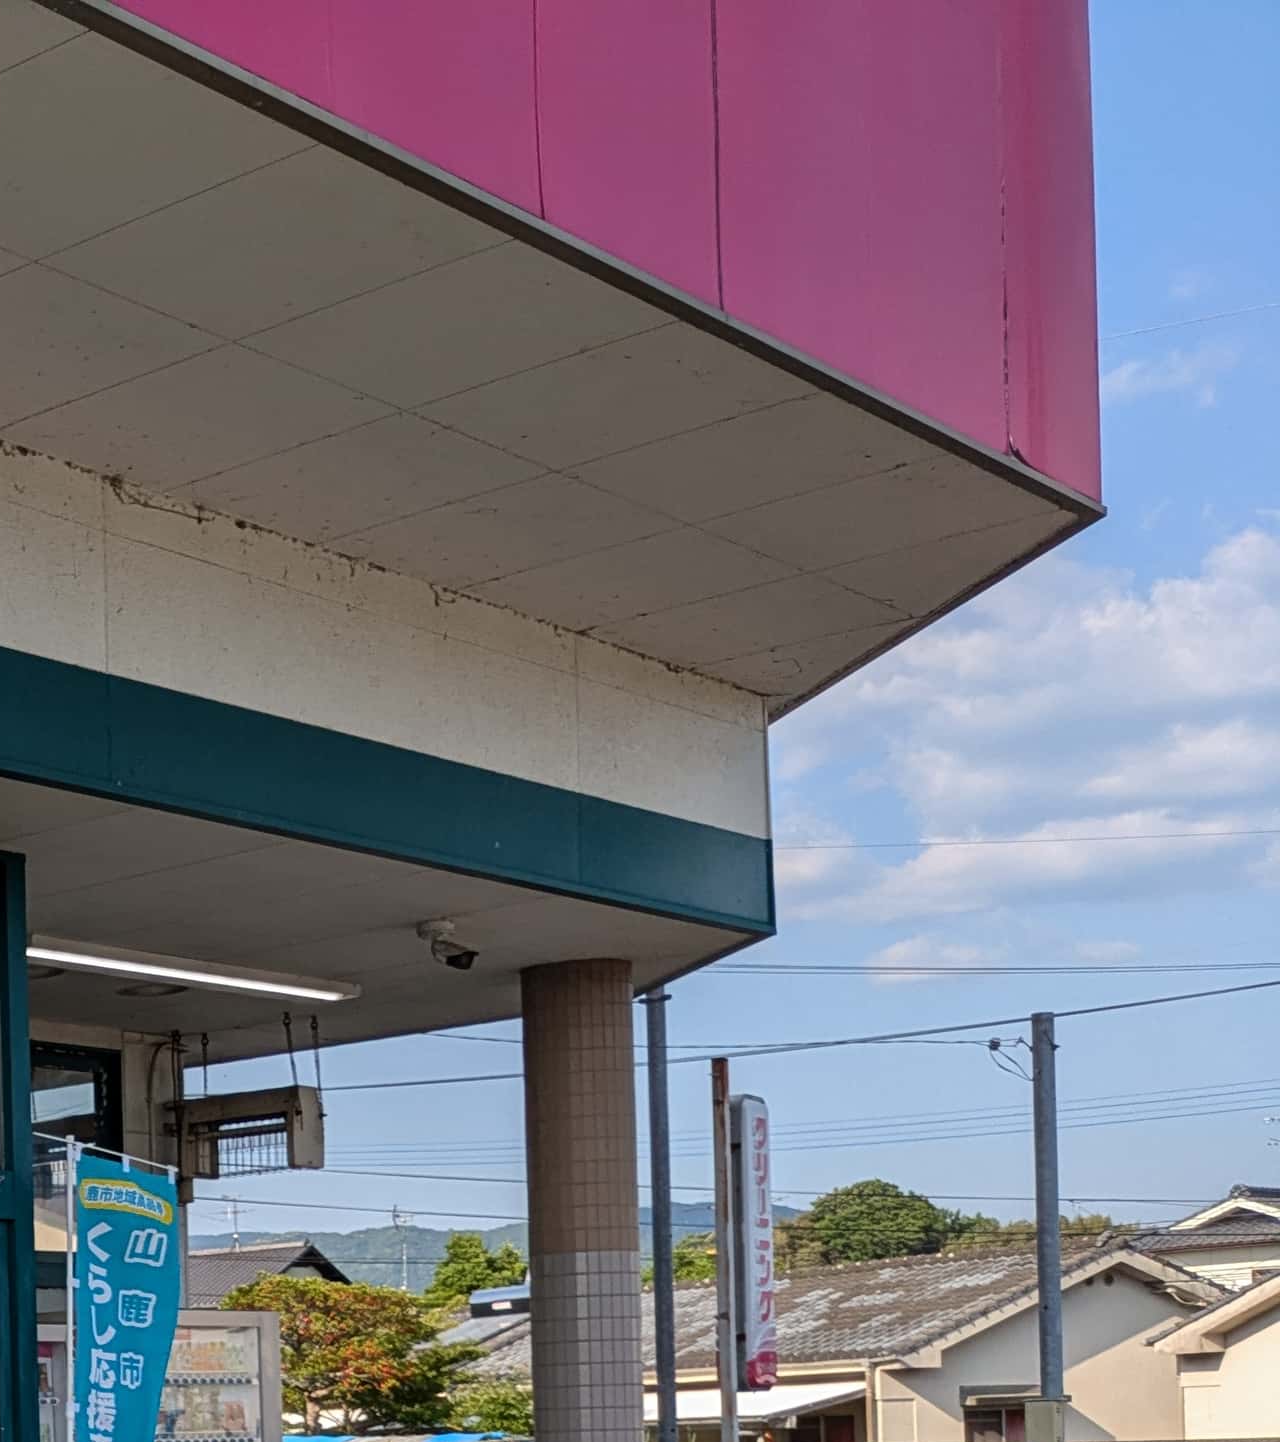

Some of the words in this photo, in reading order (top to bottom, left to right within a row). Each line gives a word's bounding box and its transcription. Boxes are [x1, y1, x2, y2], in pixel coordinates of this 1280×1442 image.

[119, 1228, 168, 1390] 山鹿市
[752, 1117, 774, 1323] クリーニング
